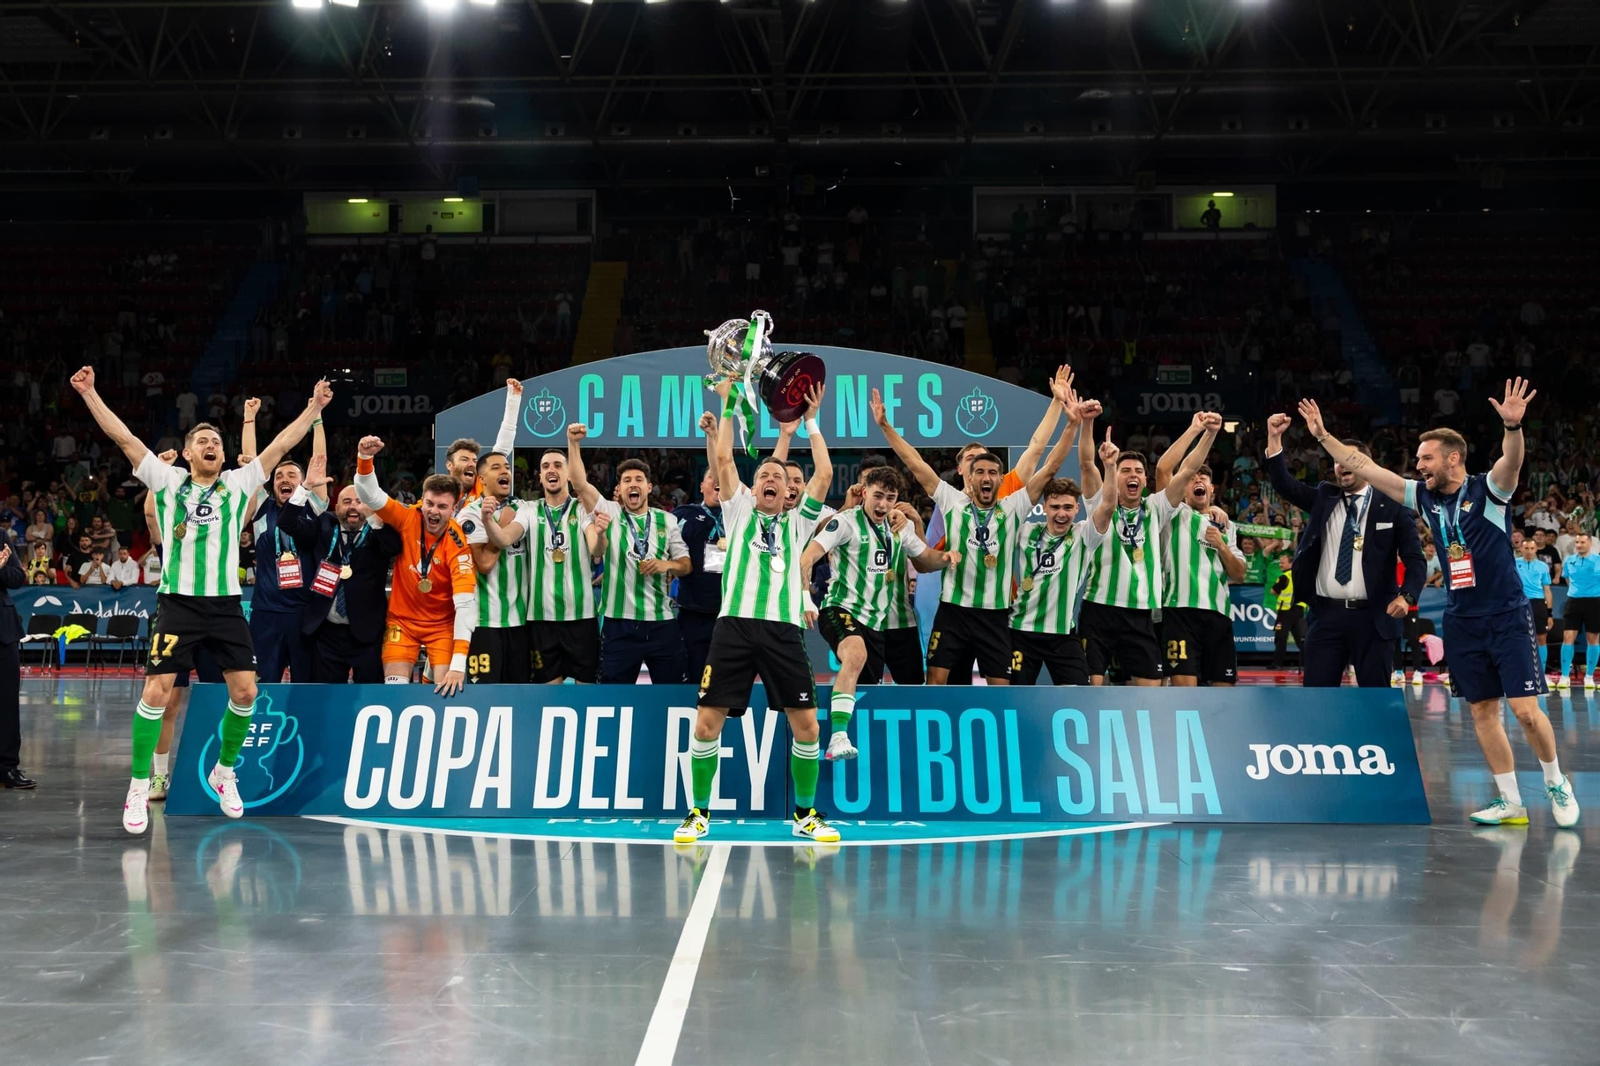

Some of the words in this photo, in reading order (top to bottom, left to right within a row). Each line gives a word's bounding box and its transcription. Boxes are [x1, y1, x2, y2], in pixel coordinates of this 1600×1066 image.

[579, 373, 943, 439] CAMNES
[187, 515, 220, 524] inetwork
[150, 632, 179, 657] 17
[1167, 640, 1187, 660] 21
[469, 653, 490, 675] 99
[701, 664, 712, 689] 8
[343, 705, 512, 811] COPA
[533, 705, 644, 811] DEL
[663, 706, 779, 811] REY
[817, 691, 1041, 814] ÚTBOL
[1052, 708, 1223, 815] SALA
